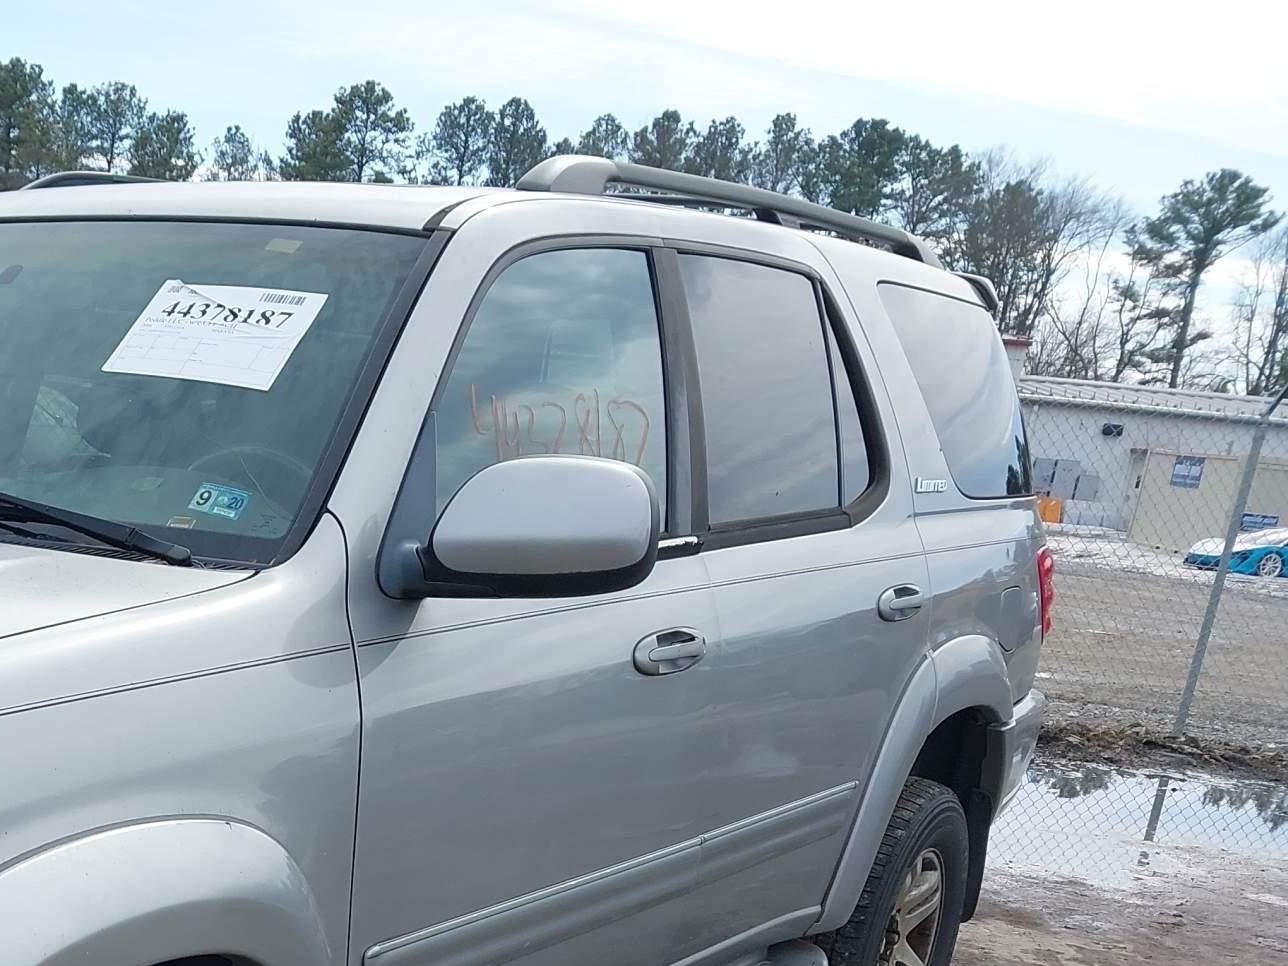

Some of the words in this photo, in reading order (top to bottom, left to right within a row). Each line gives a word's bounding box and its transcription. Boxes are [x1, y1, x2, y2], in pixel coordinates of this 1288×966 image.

[163, 301, 295, 328] 44378187
[196, 490, 212, 506] 9
[227, 496, 244, 510] 20
